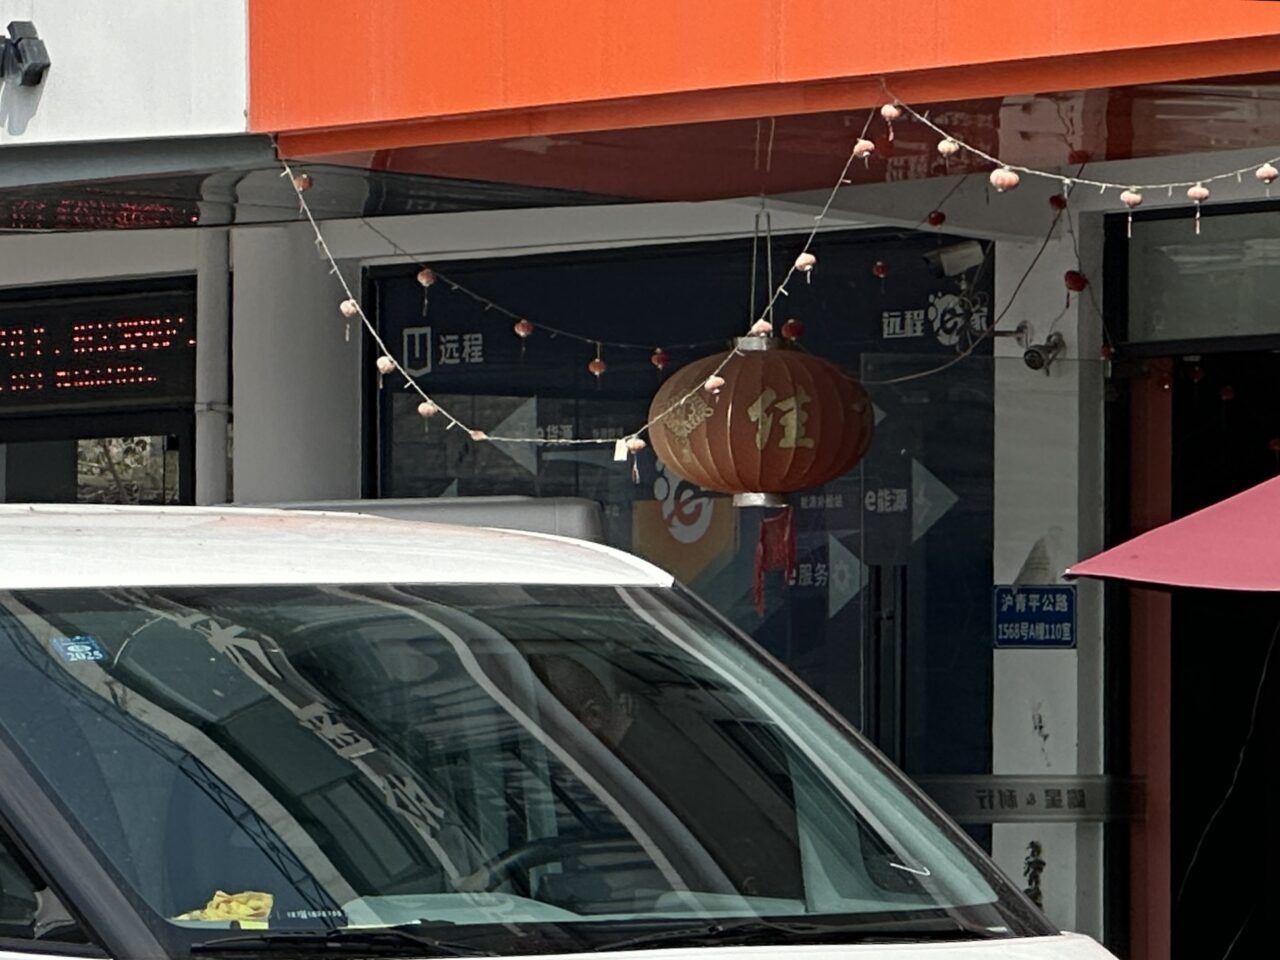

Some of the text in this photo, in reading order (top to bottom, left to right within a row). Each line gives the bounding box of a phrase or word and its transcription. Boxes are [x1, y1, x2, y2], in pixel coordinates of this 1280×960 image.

[438, 332, 484, 365] 远程
[746, 386, 816, 450] 佳
[864, 488, 908, 512] e能源
[1000, 593, 1069, 613] 沪青平公路
